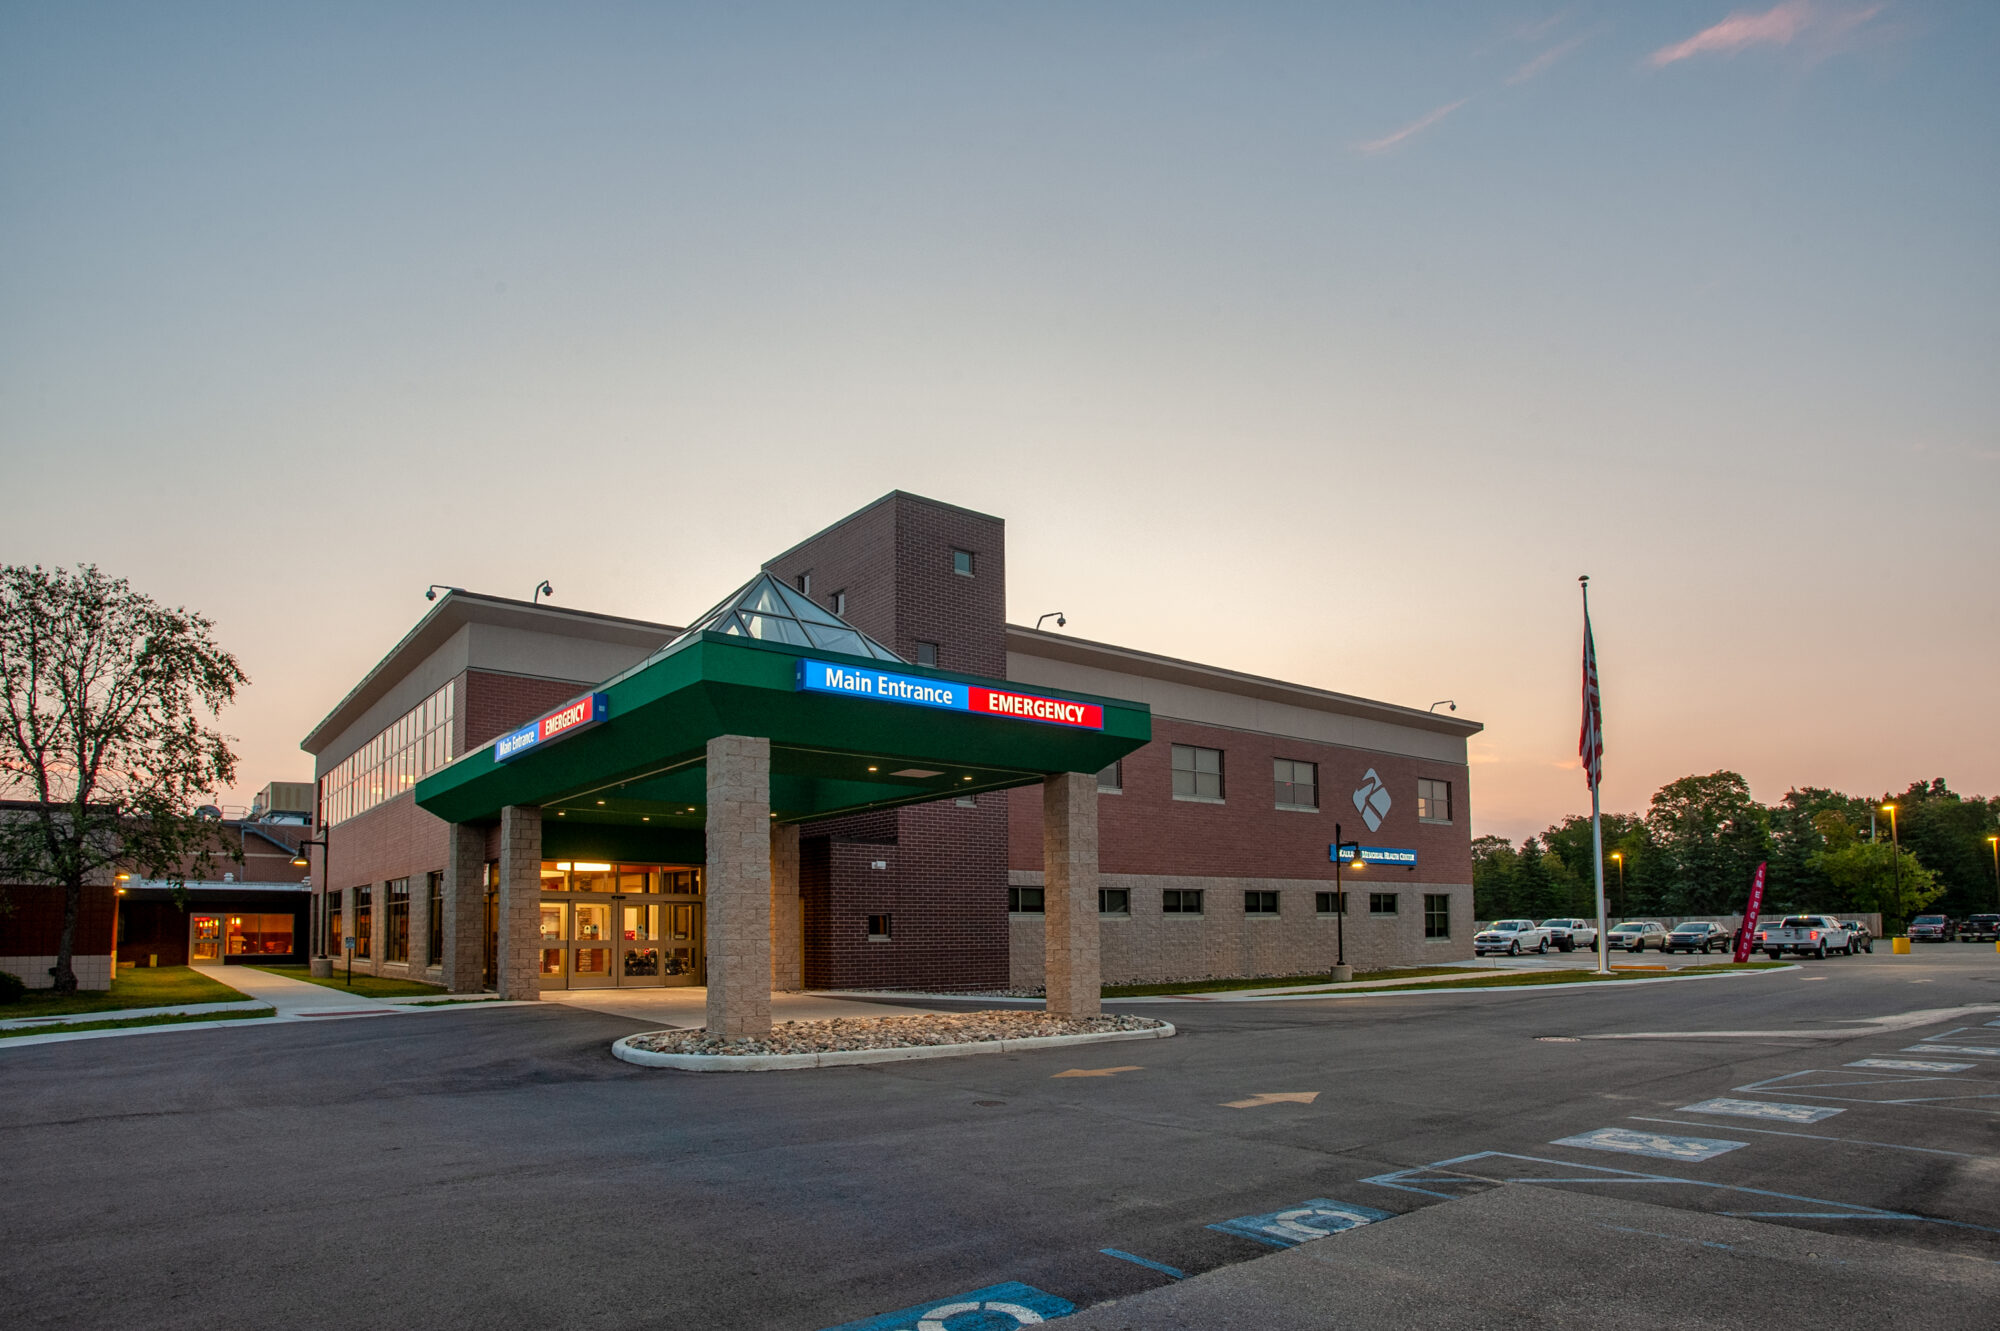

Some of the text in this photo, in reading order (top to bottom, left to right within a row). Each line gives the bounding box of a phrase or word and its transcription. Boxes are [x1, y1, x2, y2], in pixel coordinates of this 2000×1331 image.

[827, 667, 953, 705] Main Entrance
[545, 702, 585, 736] EMERGENCY
[989, 692, 1085, 723] EMERGENCY
[499, 731, 535, 756] Main Entrance
[1741, 870, 1764, 959] EMERGENCY
